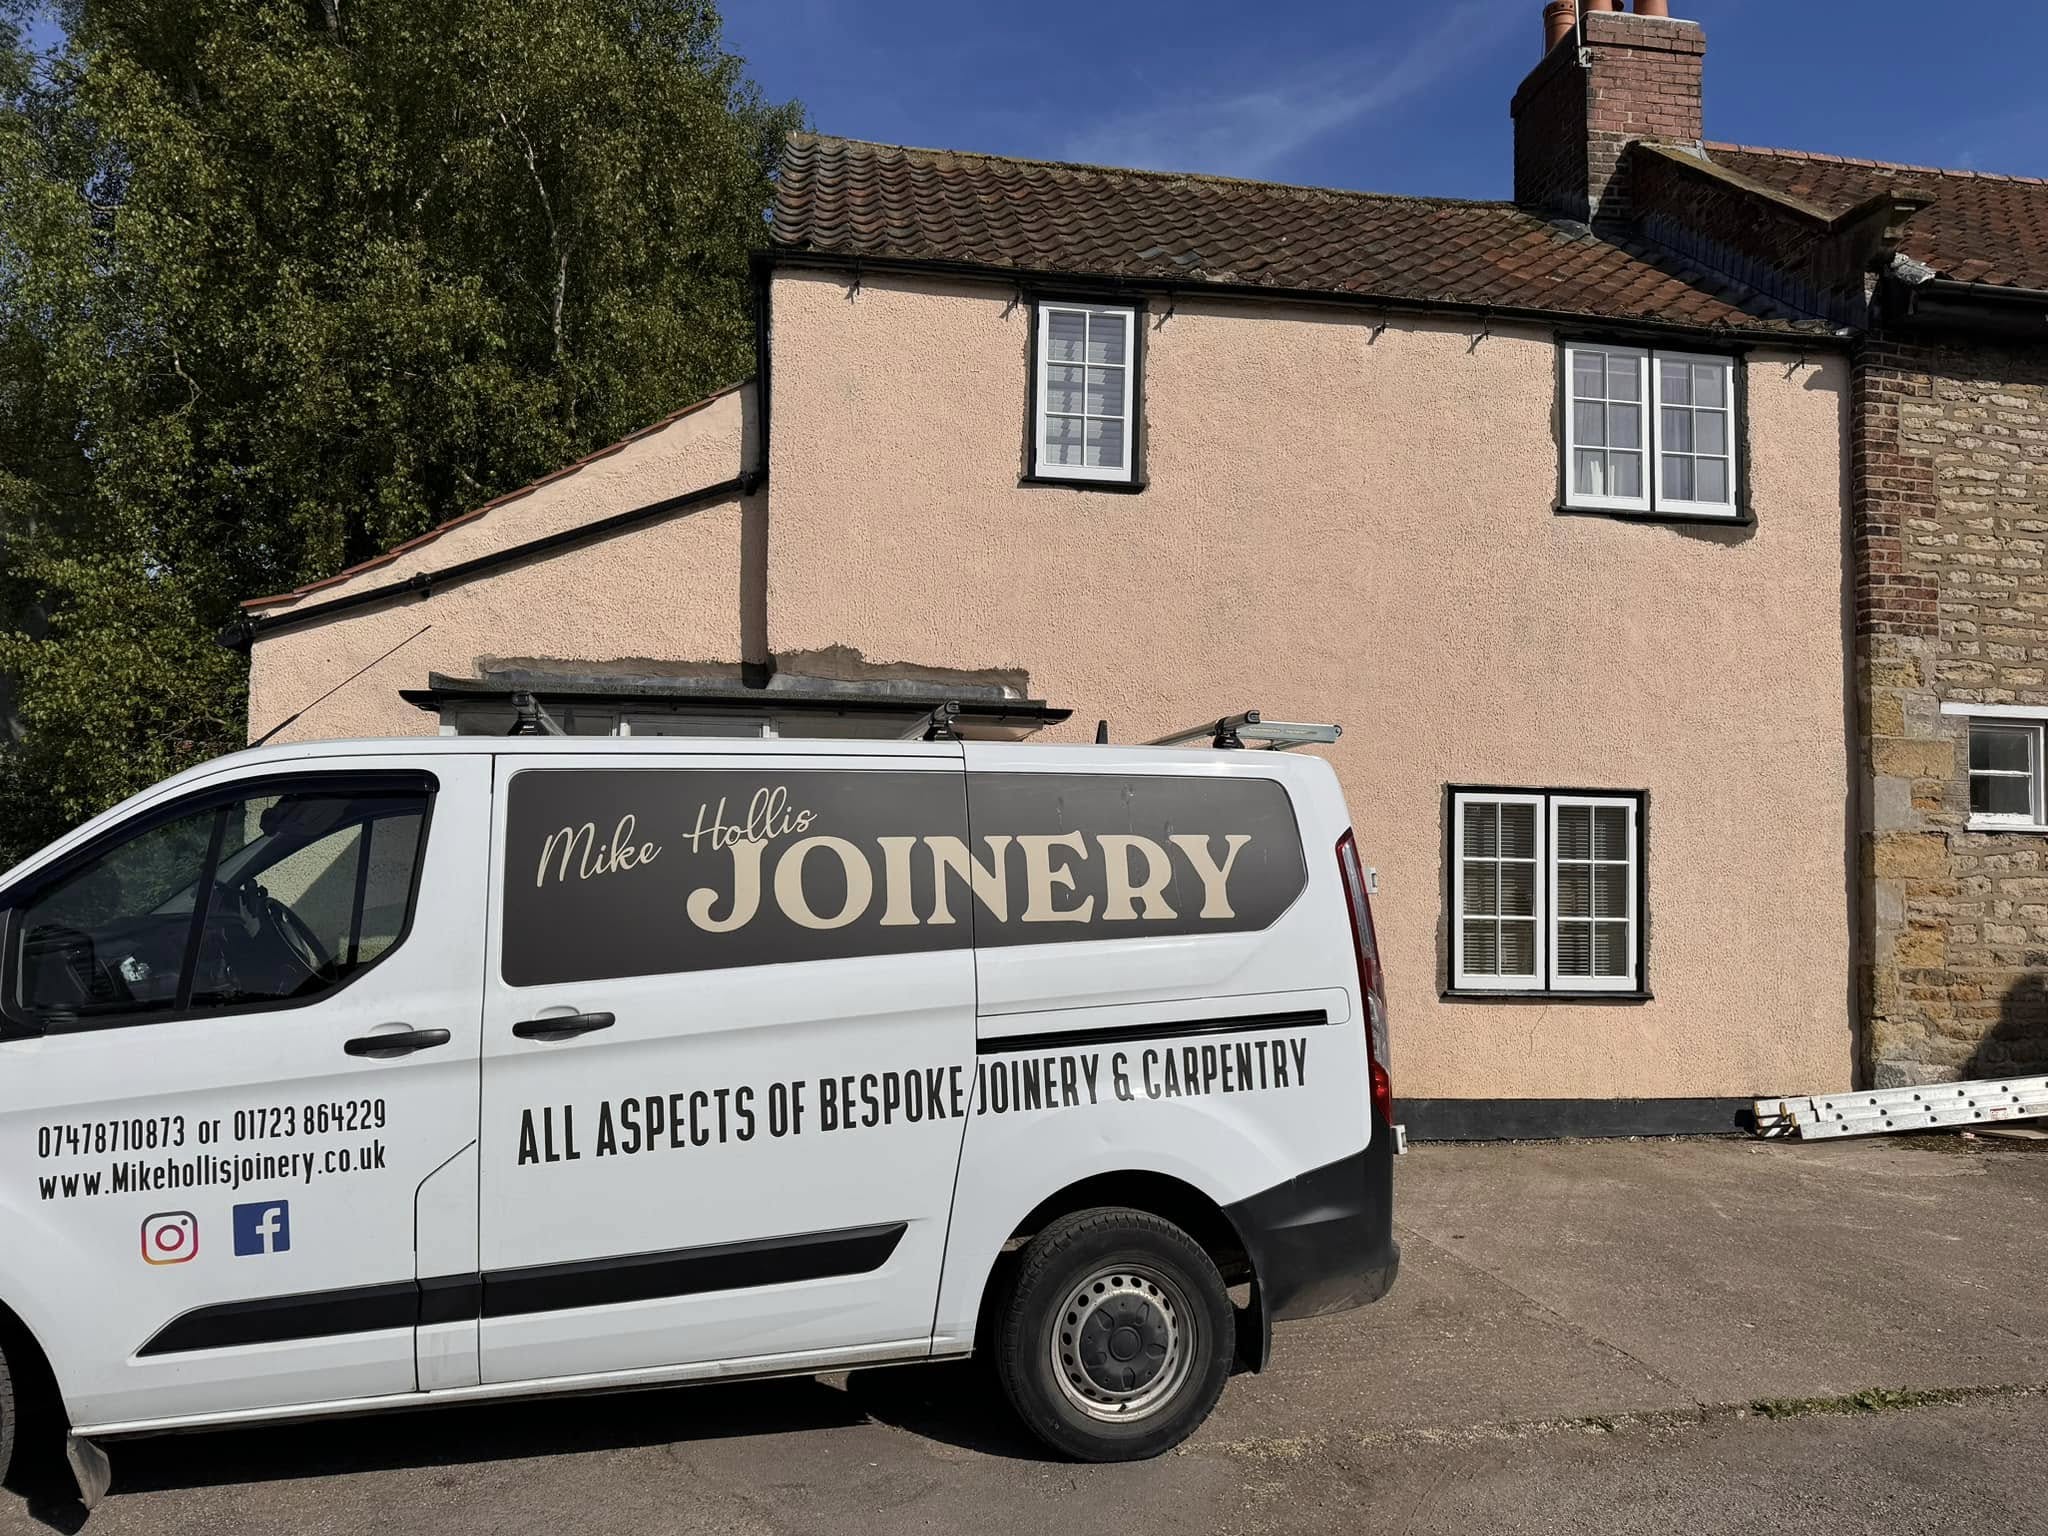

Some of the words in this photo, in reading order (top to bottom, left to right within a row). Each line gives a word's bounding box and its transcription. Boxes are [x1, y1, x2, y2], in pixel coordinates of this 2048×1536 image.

[535, 814, 662, 888] Mike
[683, 787, 818, 854] Hollis
[685, 829, 1252, 933] JOINERY
[38, 1116, 185, 1157] 07478710873
[198, 1119, 222, 1144] or
[234, 1106, 296, 1141] 01723
[303, 1098, 386, 1135] 864229
[517, 1105, 581, 1166] ALL
[596, 1086, 755, 1156] ASPECTS
[769, 1081, 806, 1137] OF
[819, 1067, 963, 1131] BESPOKE
[976, 1053, 1098, 1115] JOINERY
[1112, 1052, 1134, 1102] &
[1144, 1038, 1308, 1099] CARPENTRY
[38, 1140, 386, 1200] www.Mikehollisjoinery.co.uk
